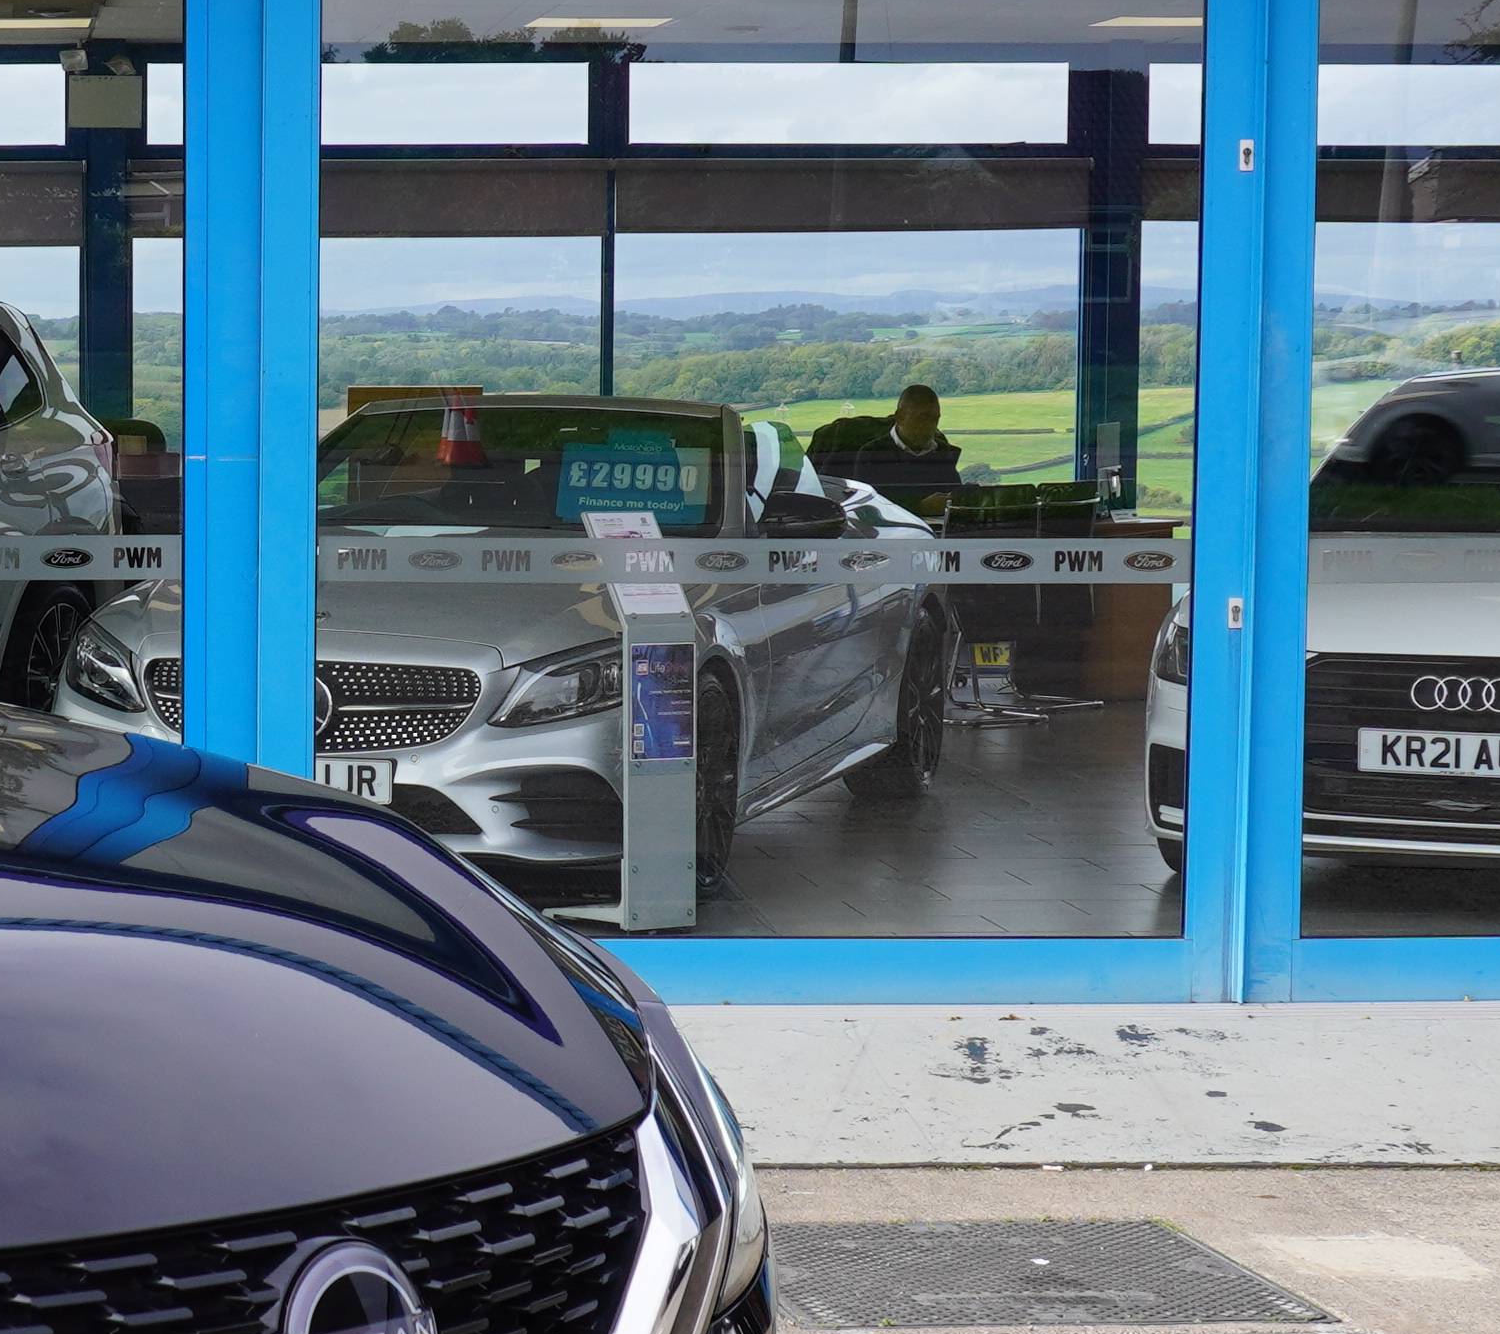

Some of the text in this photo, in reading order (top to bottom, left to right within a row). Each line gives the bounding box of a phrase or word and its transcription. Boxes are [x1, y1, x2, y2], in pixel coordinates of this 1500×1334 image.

[568, 461, 699, 492] £29990
[578, 496, 685, 512] Finance me today!
[113, 547, 162, 569] PWM
[338, 548, 387, 571] PWM
[481, 549, 531, 572] PWM
[625, 550, 674, 573] PWM
[768, 551, 817, 573] PWM
[911, 551, 960, 573] PWM
[1054, 551, 1104, 573] PWM
[1381, 734, 1461, 768] KR21
